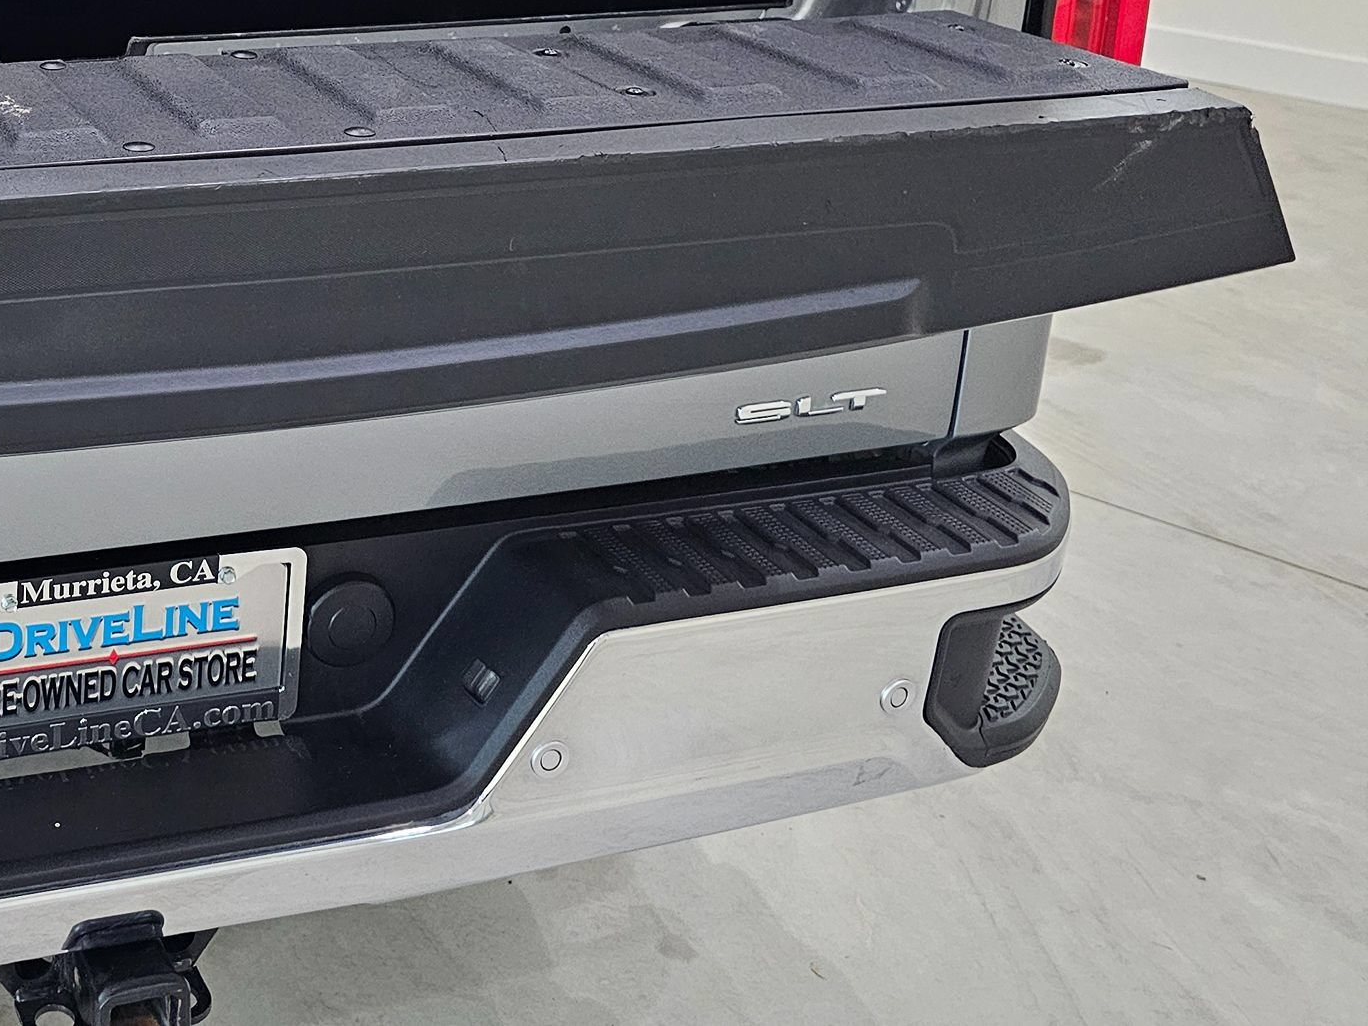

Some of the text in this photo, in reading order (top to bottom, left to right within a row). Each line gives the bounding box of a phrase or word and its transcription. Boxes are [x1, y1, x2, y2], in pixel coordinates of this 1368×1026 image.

[735, 387, 887, 424] SLT
[20, 558, 214, 605] Murrieta, CA
[122, 656, 172, 699] CAR
[178, 647, 259, 692] STORE
